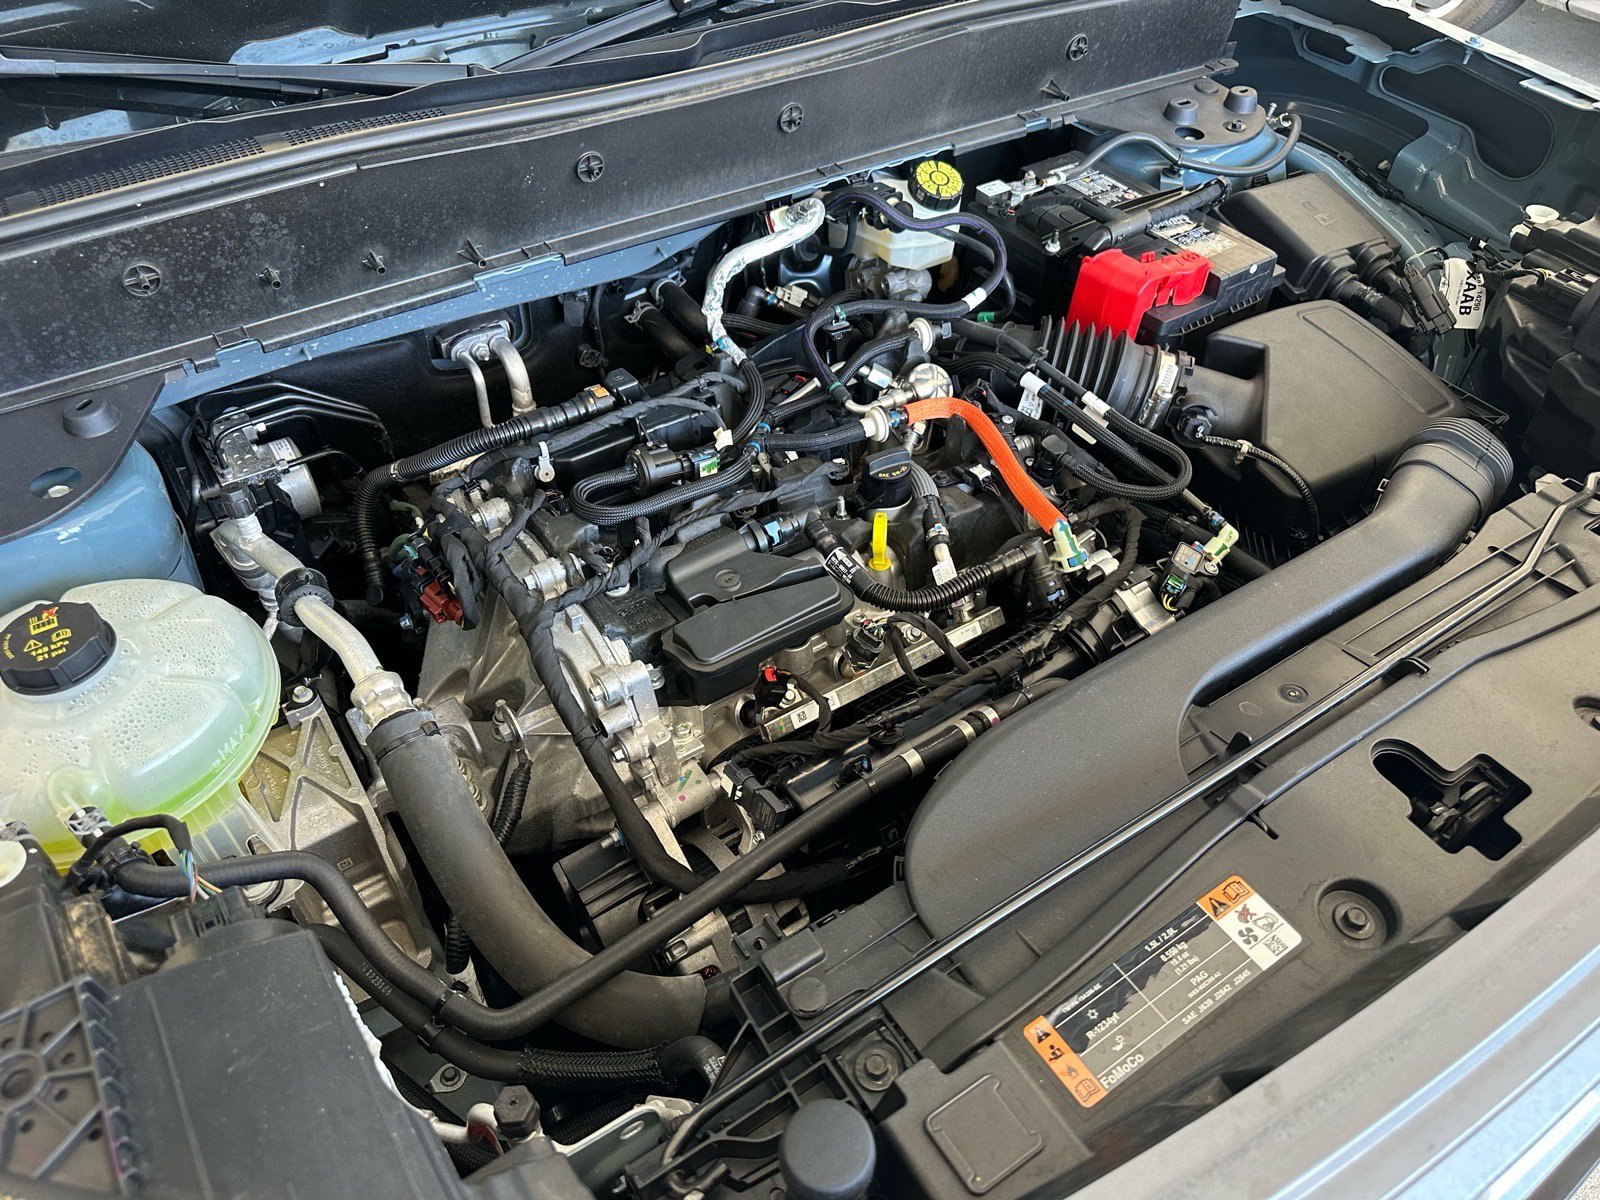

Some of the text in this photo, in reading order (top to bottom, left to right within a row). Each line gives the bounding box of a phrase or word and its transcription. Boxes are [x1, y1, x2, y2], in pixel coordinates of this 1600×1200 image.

[1459, 269, 1477, 315] XAAB
[1472, 291, 1483, 311] 14290
[1144, 940, 1161, 952] 1.5L
[1161, 927, 1178, 940] 2.0L
[1160, 941, 1189, 962] 0.550 kg
[1190, 970, 1208, 986] PAG
[1182, 1010, 1198, 1025] SAE
[1198, 998, 1214, 1013] J639
[1085, 1011, 1120, 1040] R-1234yf
[1099, 1053, 1144, 1089] FoMoCo
